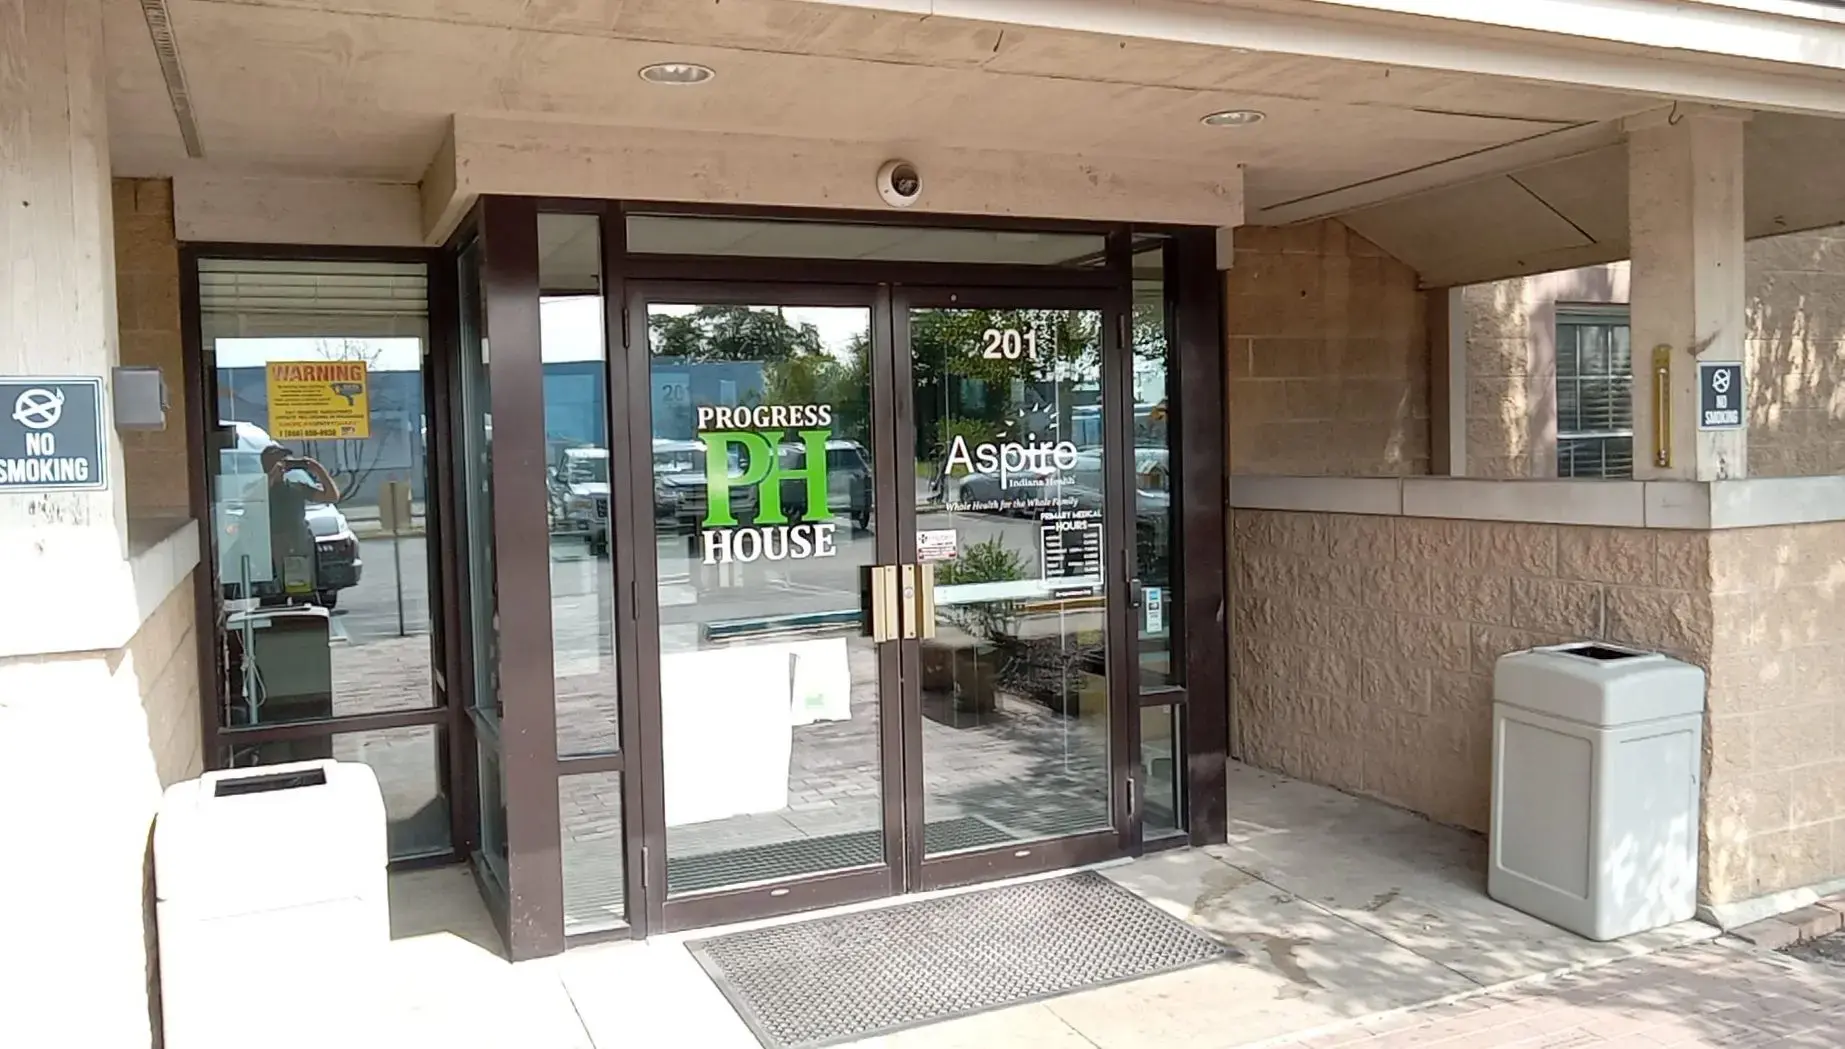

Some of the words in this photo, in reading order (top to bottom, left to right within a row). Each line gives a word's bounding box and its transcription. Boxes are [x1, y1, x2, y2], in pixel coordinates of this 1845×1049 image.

[982, 328, 1037, 360] 201
[272, 364, 362, 382] WARNING
[1716, 395, 1727, 409] NO
[697, 404, 833, 429] PROGRESS
[1705, 410, 1738, 424] SMOKING
[25, 431, 56, 457] NO
[0, 457, 89, 483] SMOKING
[944, 433, 1079, 490] Aspire
[698, 430, 835, 527] PH
[1008, 479, 1044, 488] Indiana
[1045, 475, 1077, 487] Health
[945, 502, 971, 512] Whole
[972, 500, 999, 511] Health
[999, 499, 1013, 511] for
[1013, 498, 1026, 507] the
[1027, 498, 1051, 507] Whole
[1052, 497, 1079, 508] Family
[1072, 509, 1102, 519] MEDICAL
[1055, 520, 1088, 532] HOURS
[702, 523, 837, 565] HOUSE
